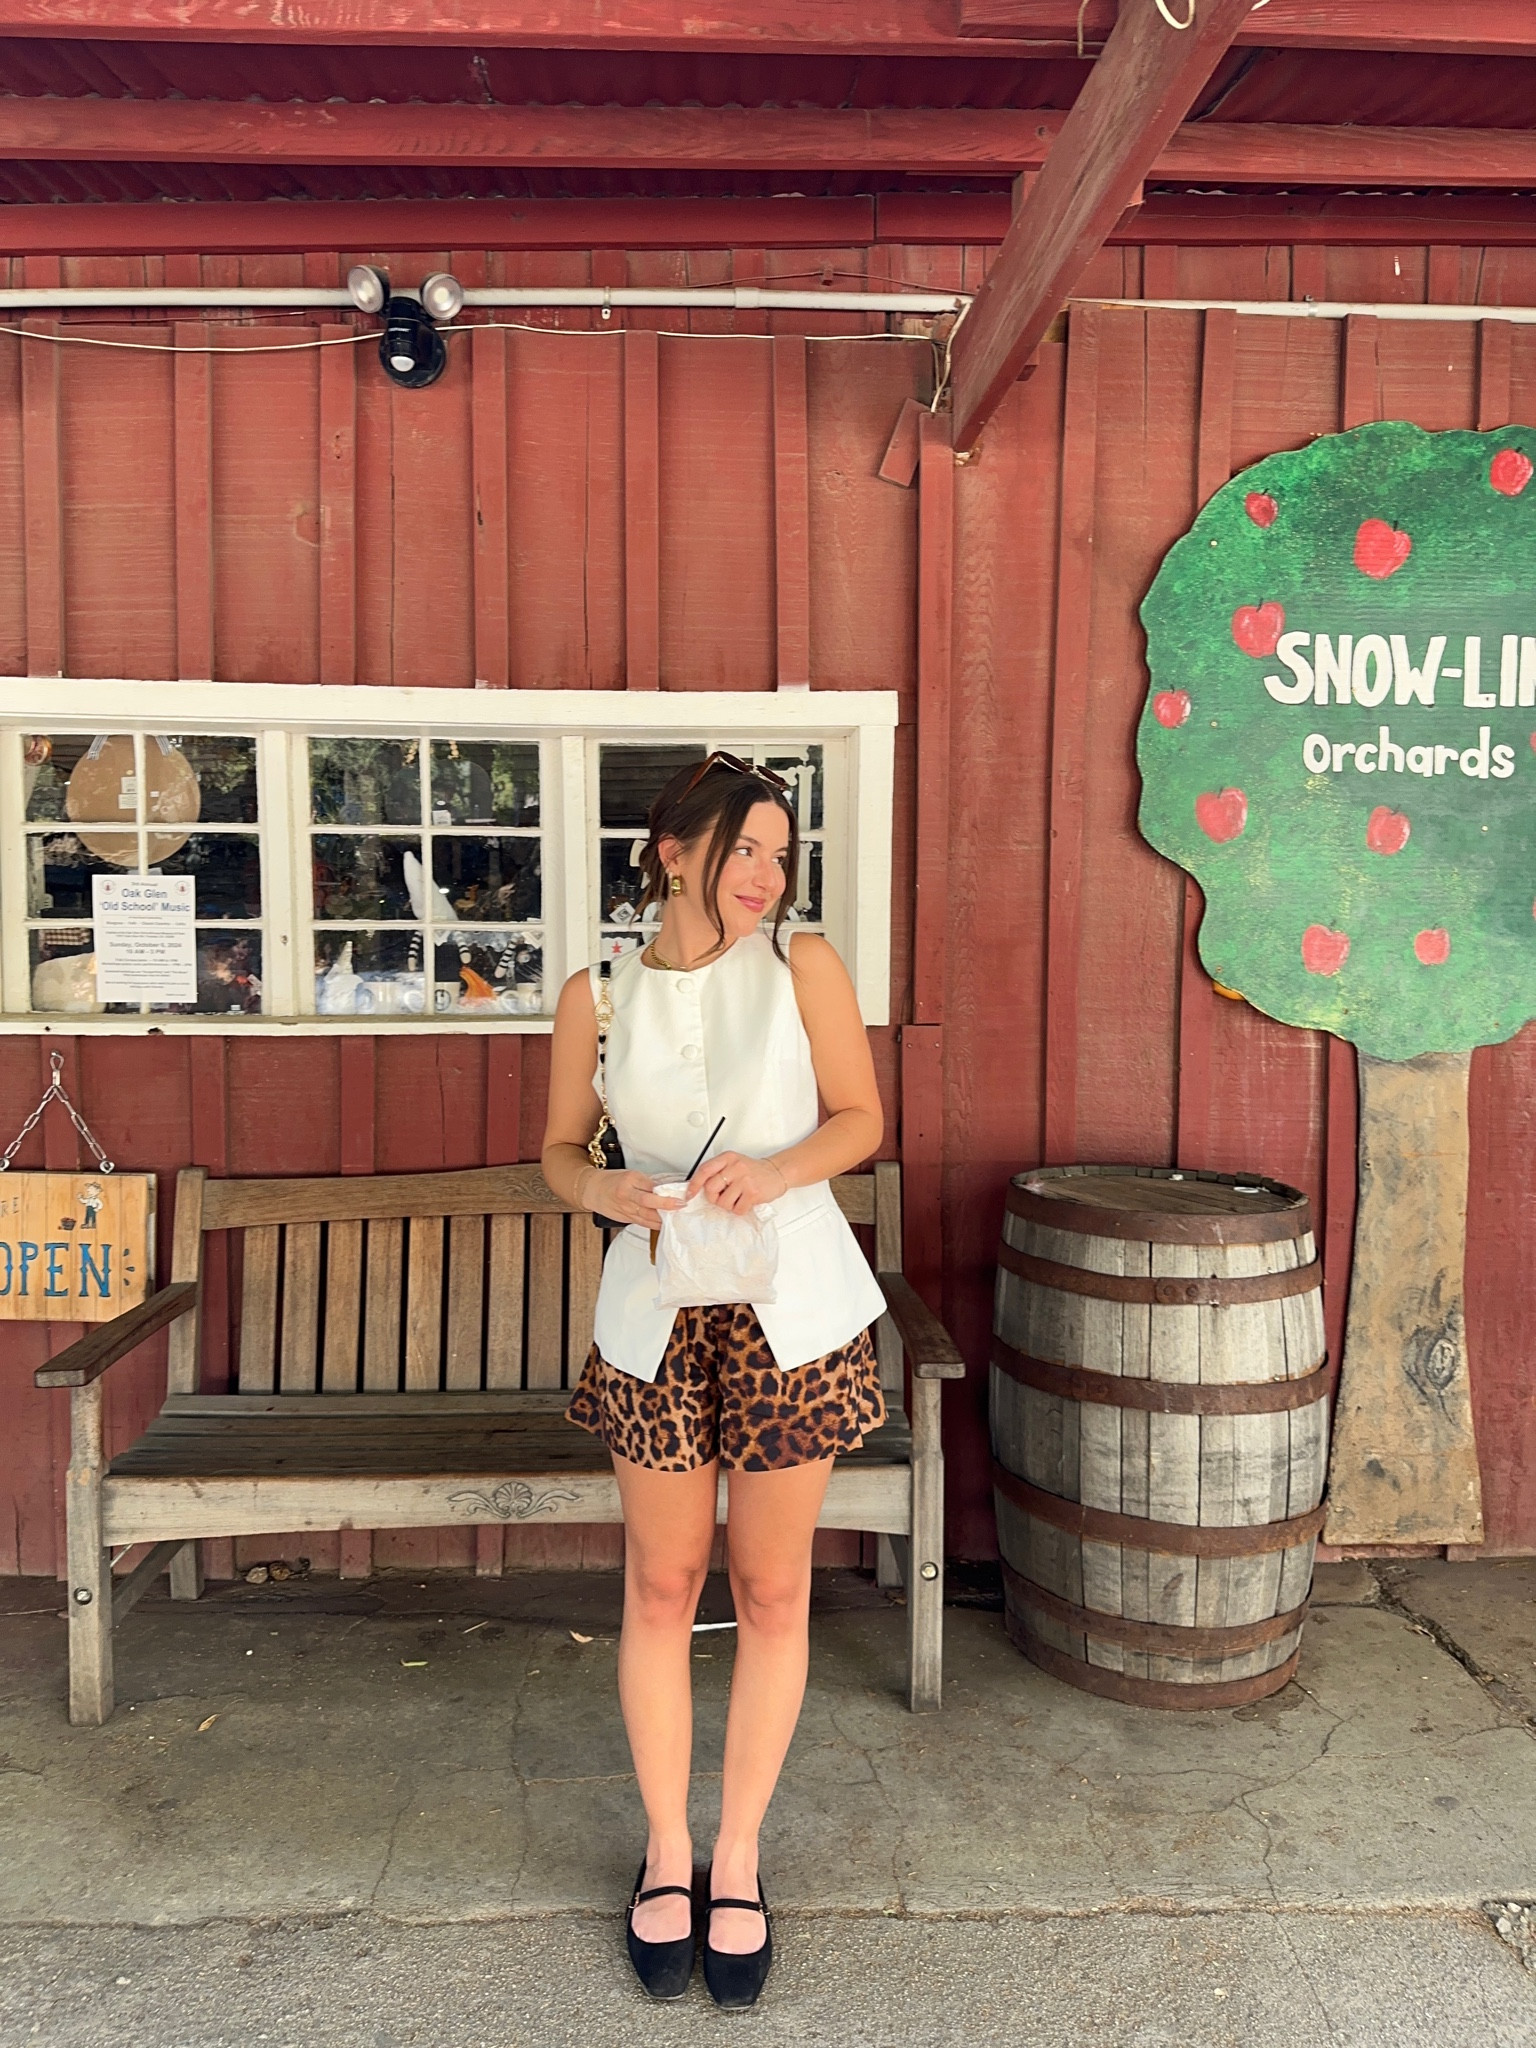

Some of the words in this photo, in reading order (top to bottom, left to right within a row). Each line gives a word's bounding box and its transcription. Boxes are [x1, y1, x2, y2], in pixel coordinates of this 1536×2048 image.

[1303, 726, 1515, 779] Orchards
[121, 888, 142, 898] Oak
[144, 888, 168, 899] Glen
[161, 902, 191, 912] Music
